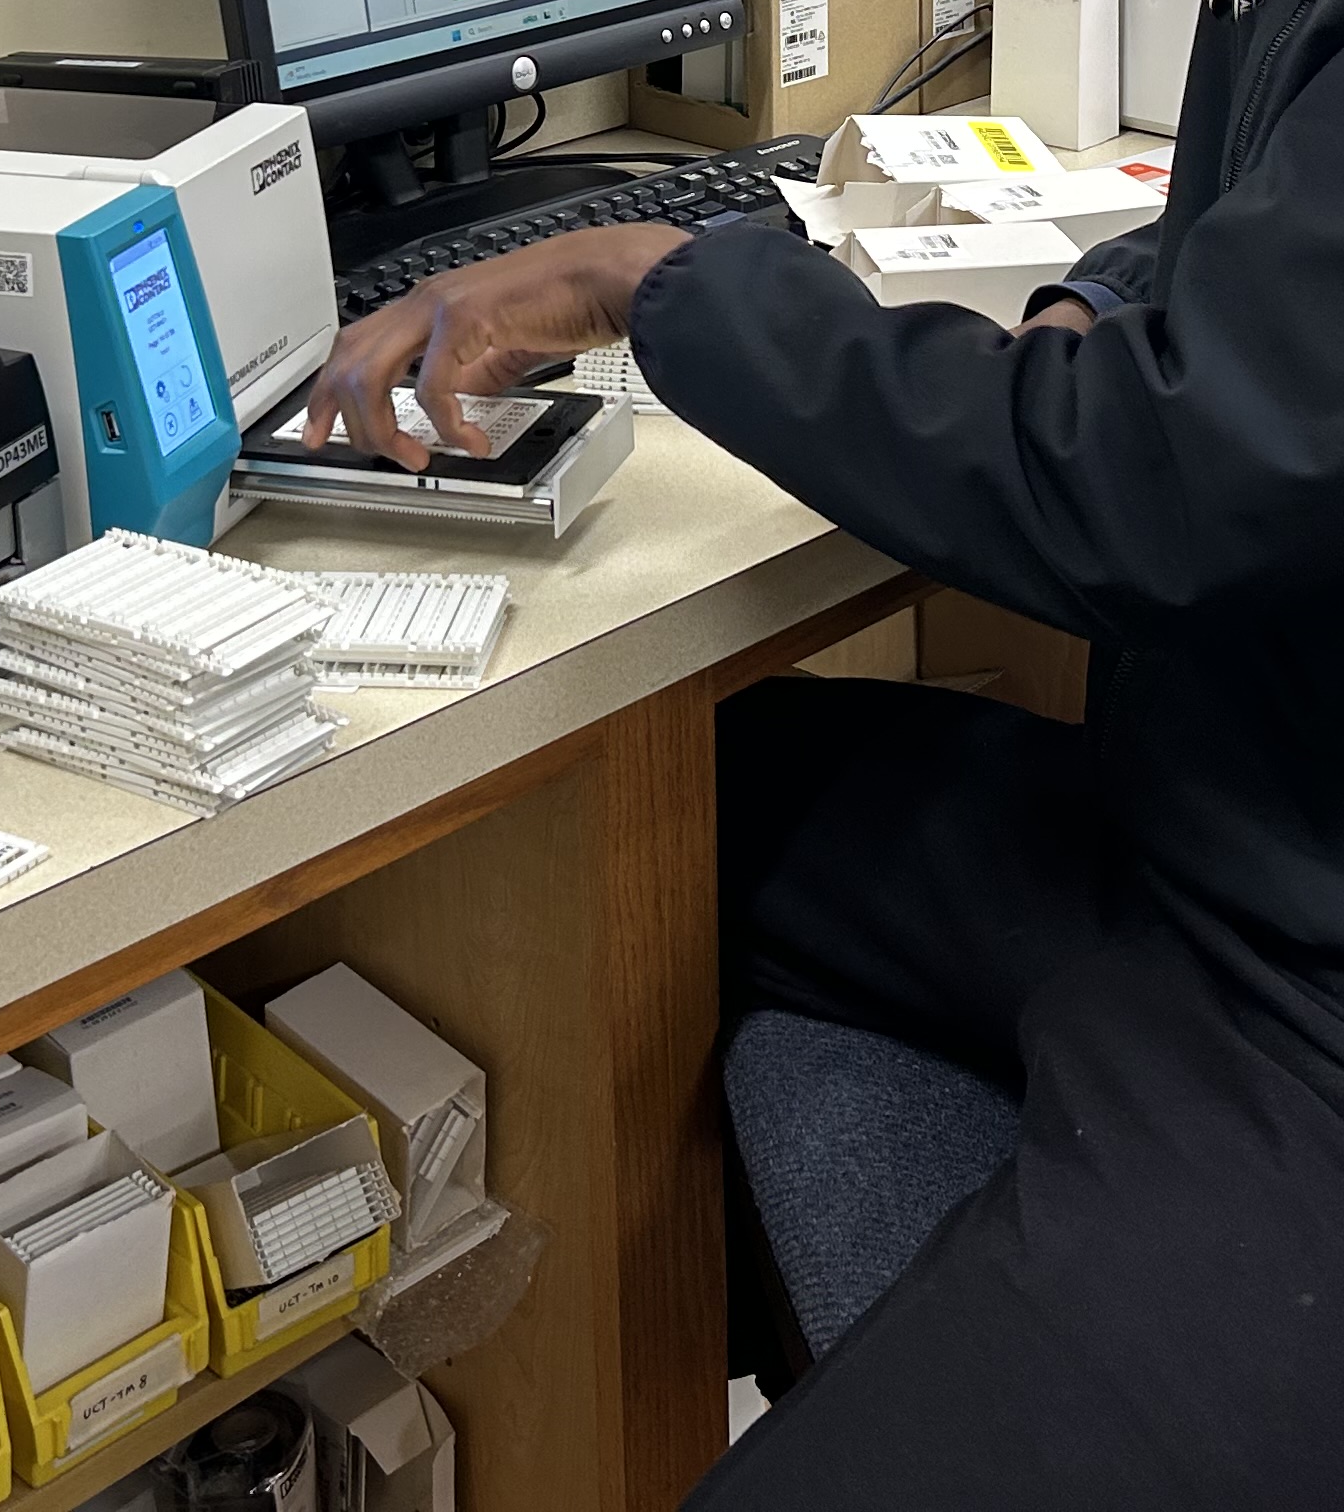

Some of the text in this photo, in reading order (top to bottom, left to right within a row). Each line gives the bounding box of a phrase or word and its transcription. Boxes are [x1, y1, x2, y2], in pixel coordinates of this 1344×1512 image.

[756, 139, 800, 155] lenovo
[266, 154, 301, 187] CONTACT
[260, 343, 278, 364] CARD
[279, 1274, 338, 1313] UCT-TM 10
[83, 1374, 147, 1420] UCT-TM 8
